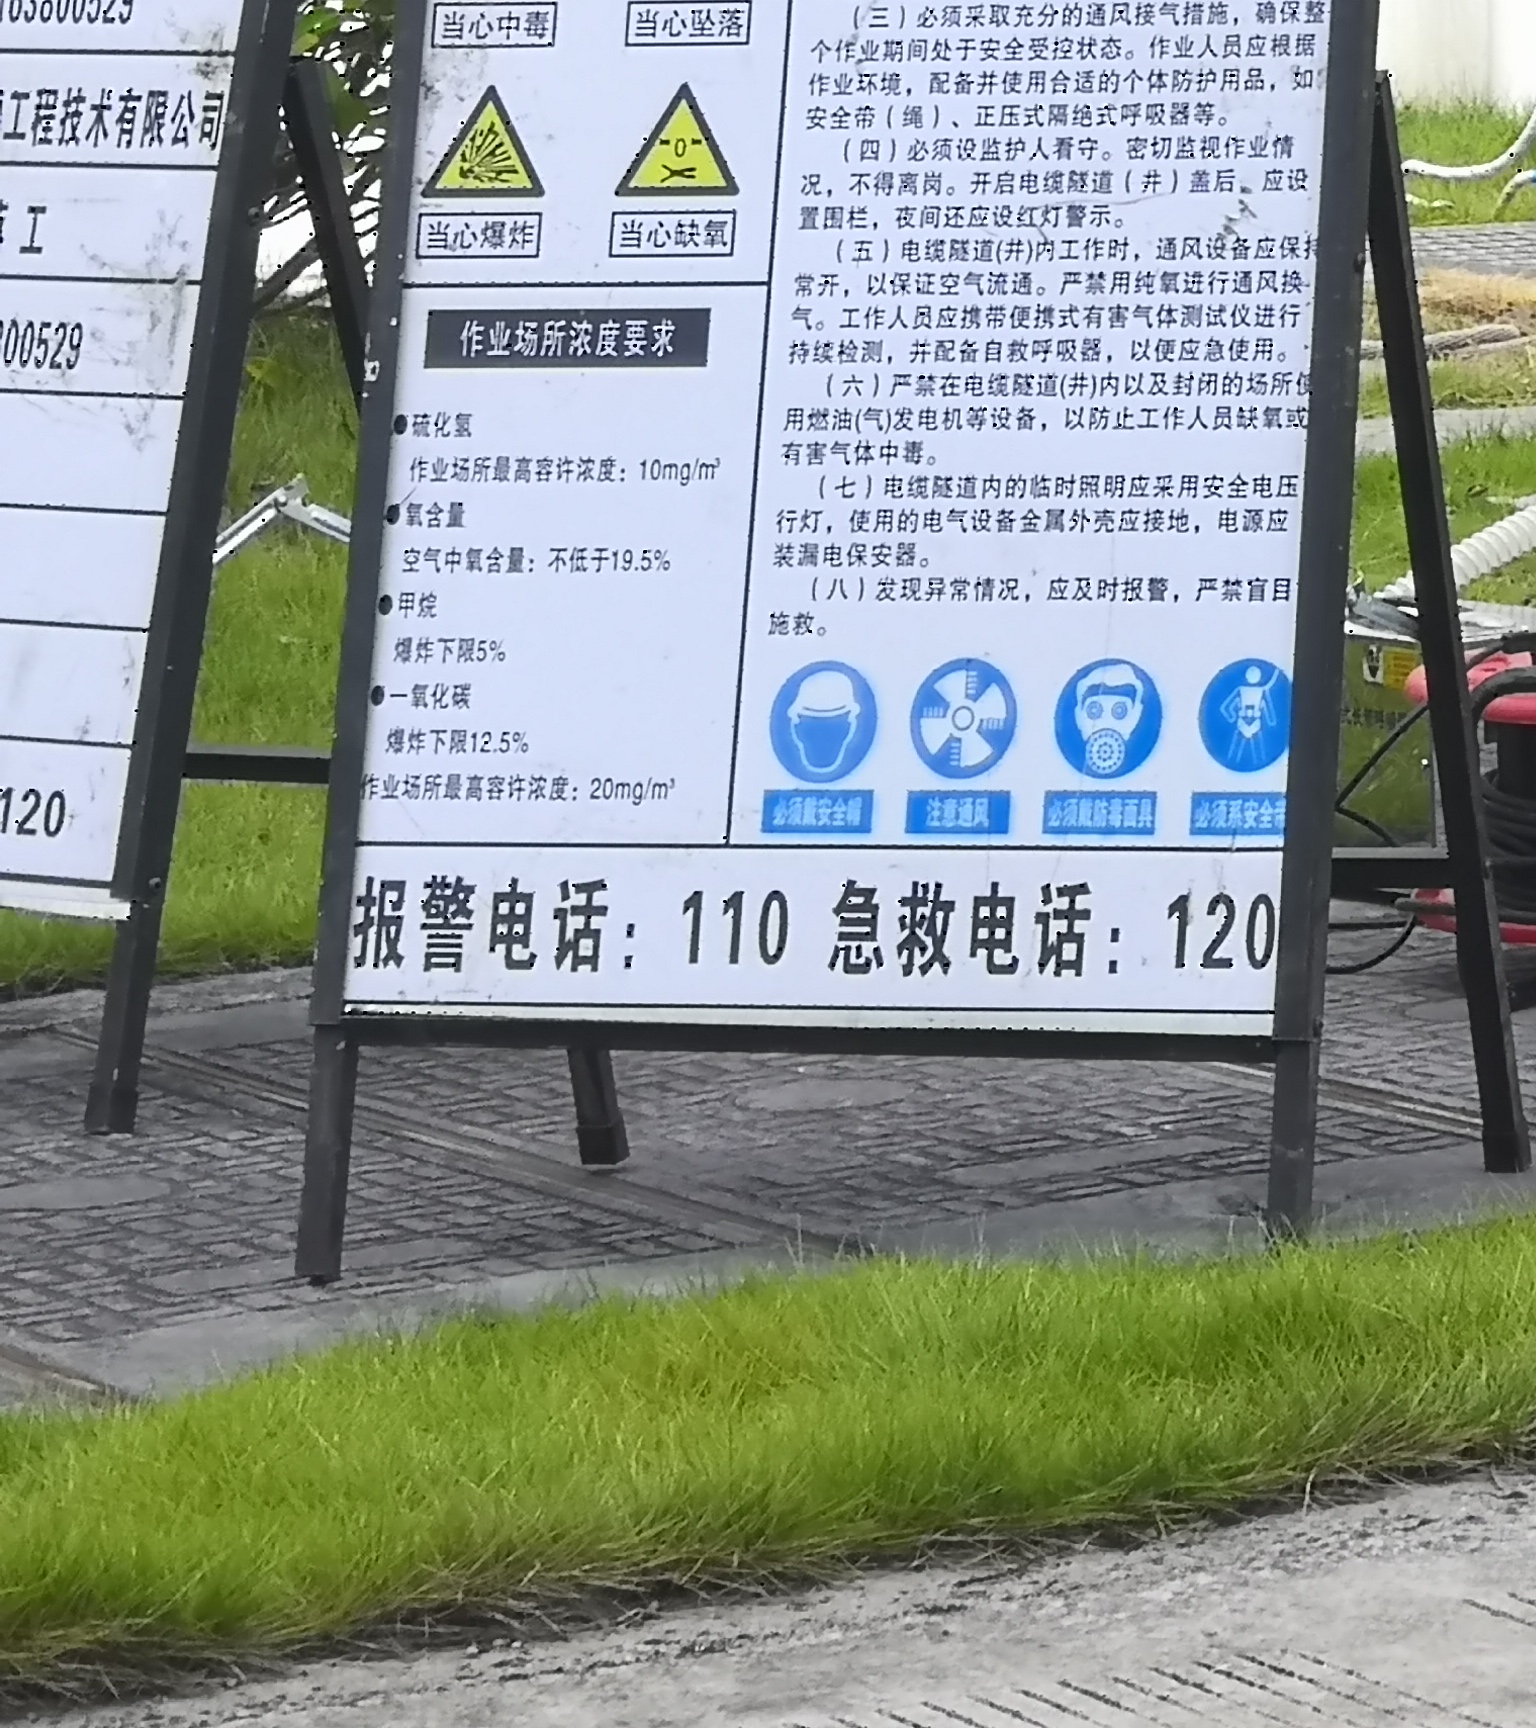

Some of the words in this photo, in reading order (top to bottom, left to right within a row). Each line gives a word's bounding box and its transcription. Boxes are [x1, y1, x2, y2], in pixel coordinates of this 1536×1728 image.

[441, 11, 549, 41] 当心中毒
[634, 8, 745, 39] 当心坠落
[0, 87, 225, 149] 工程技术有限公司
[427, 220, 536, 251] 当心爆炸
[620, 219, 728, 249] 当心缺氧
[0, 318, 83, 370] 00529
[460, 319, 676, 358] 作业场所浓度要求
[411, 412, 472, 438] 硫化氢
[405, 501, 465, 529] 氧含量
[398, 591, 438, 619] 甲烷
[768, 611, 828, 638] 施救。
[394, 637, 506, 664] 爆炸下限5%
[389, 683, 472, 710] 一氧化碳
[385, 728, 530, 755] 爆炸下限12.5%
[0, 787, 66, 837] 120
[925, 797, 990, 829] 注意通风
